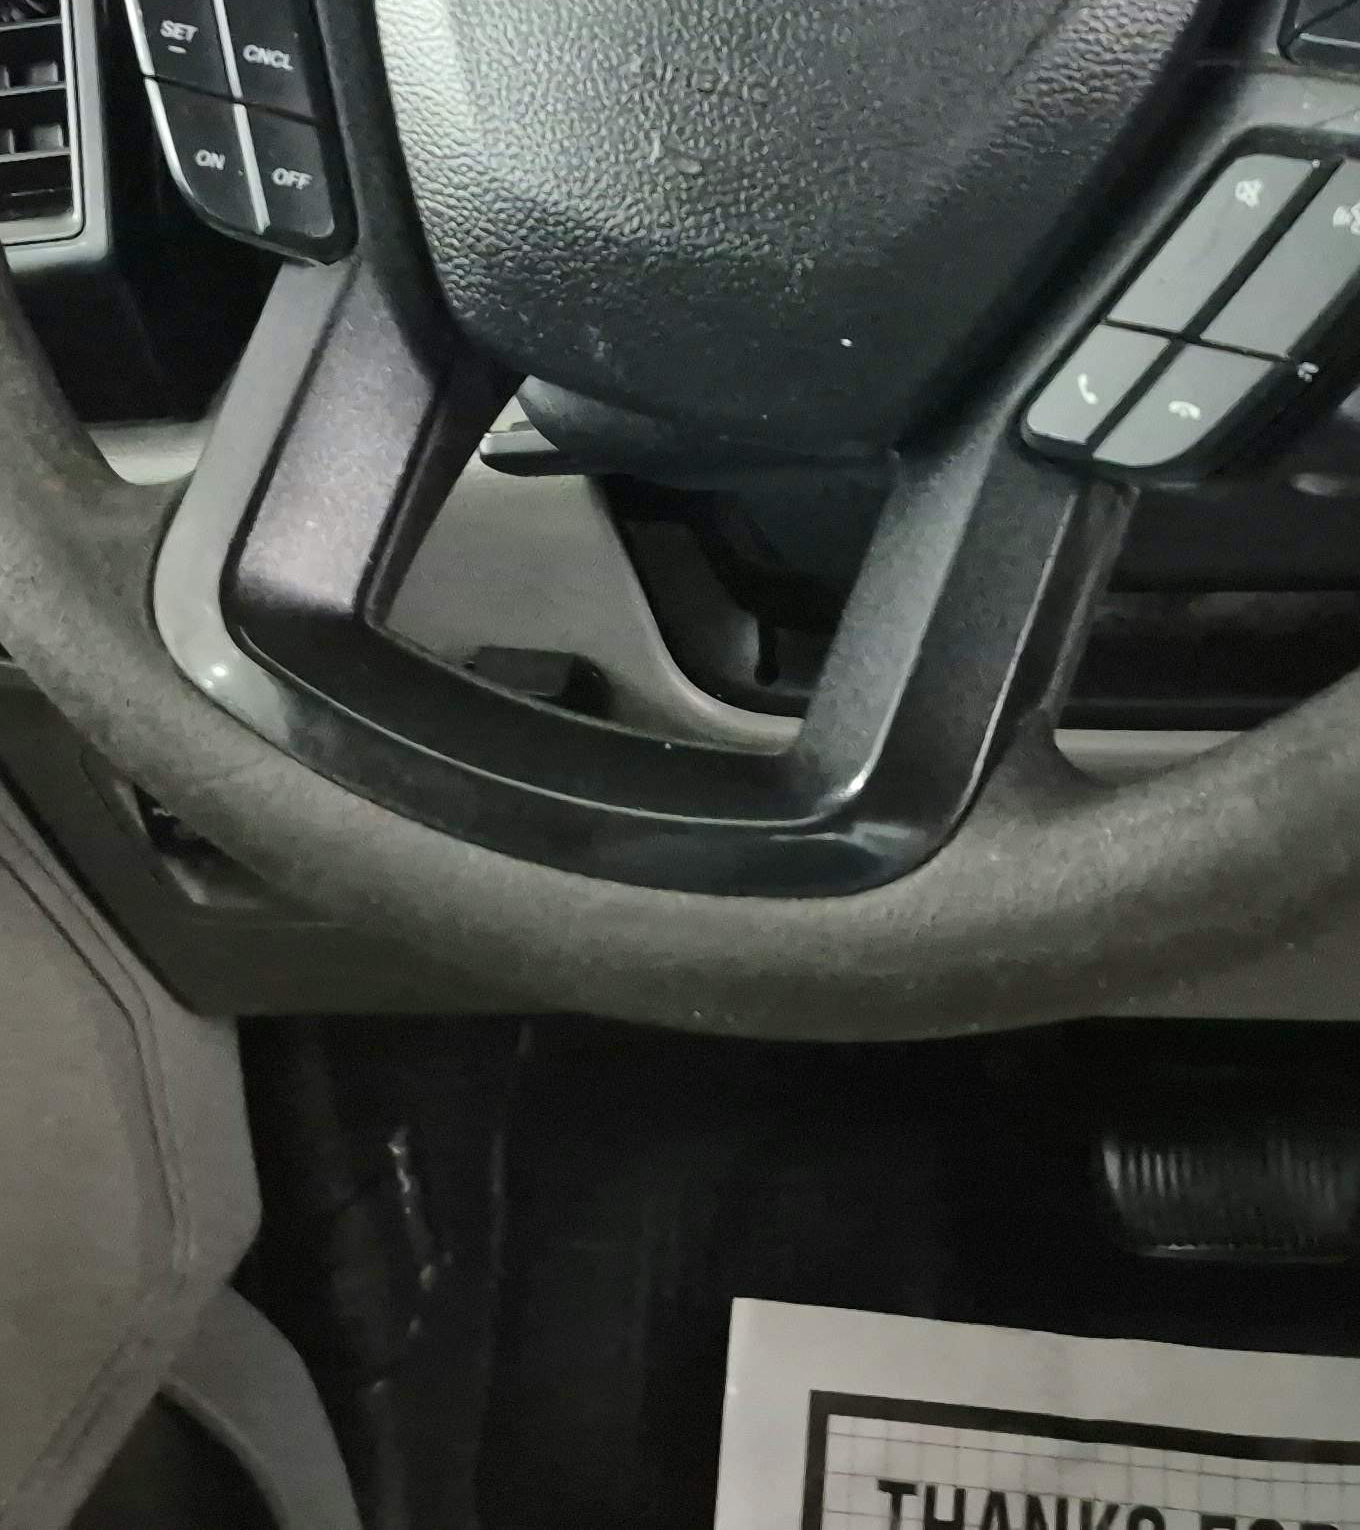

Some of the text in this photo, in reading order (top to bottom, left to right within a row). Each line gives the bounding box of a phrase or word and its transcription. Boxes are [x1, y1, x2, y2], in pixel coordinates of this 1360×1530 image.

[159, 19, 199, 42] SET
[241, 43, 294, 71] CNCL
[194, 148, 227, 171] ON
[271, 167, 313, 191] OFF
